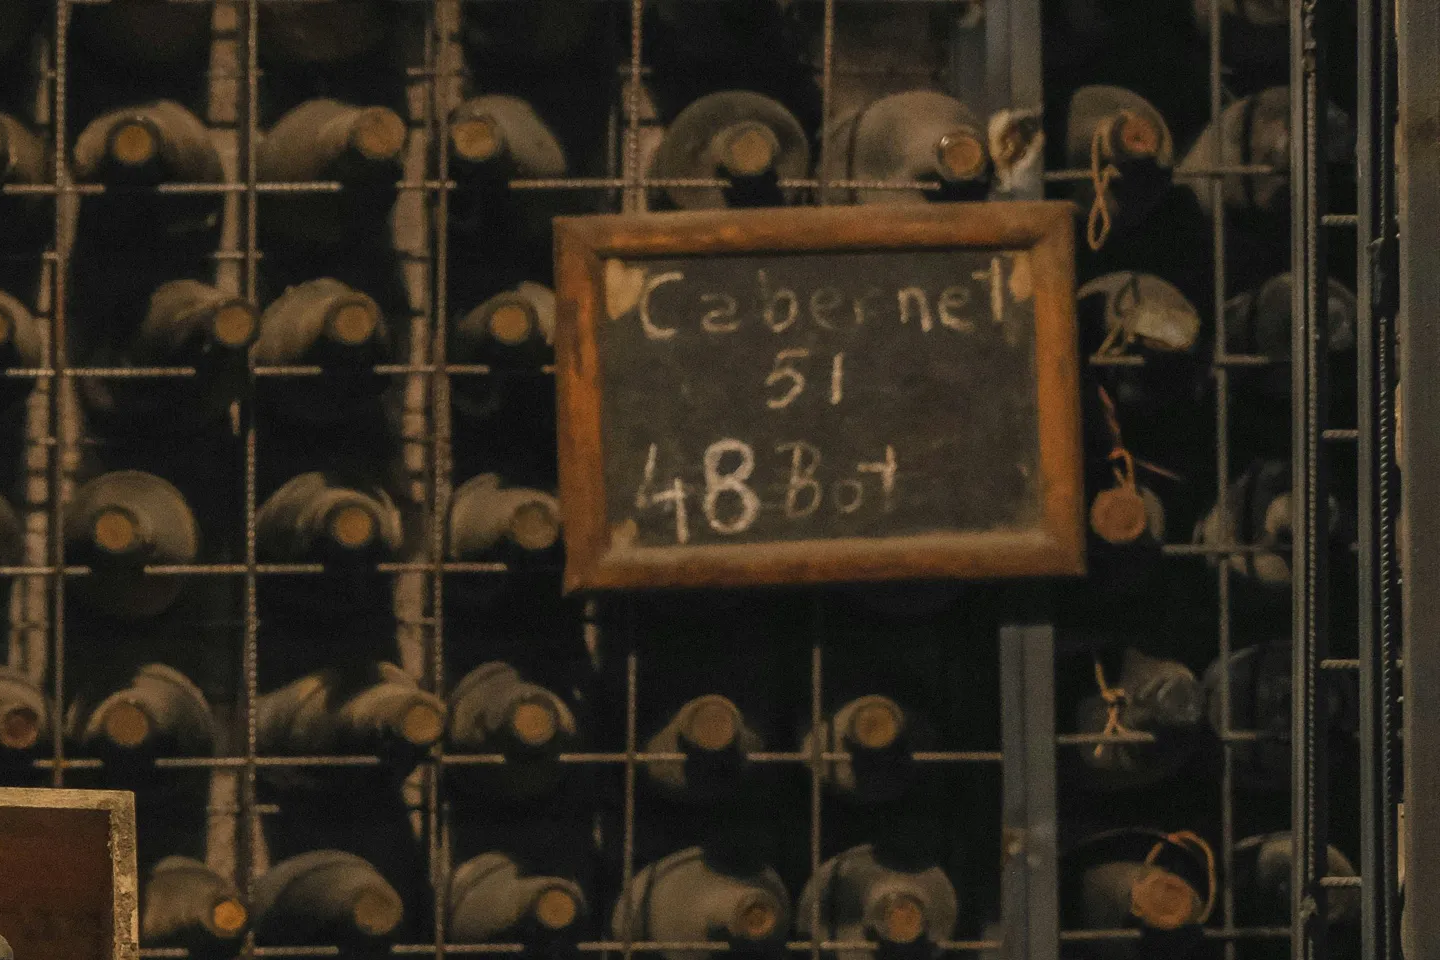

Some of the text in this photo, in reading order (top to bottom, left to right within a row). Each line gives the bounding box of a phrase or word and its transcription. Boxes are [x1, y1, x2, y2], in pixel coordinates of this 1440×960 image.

[639, 256, 1006, 340] Cabernet
[765, 347, 845, 410] 51
[635, 436, 898, 545] 48 Bot
